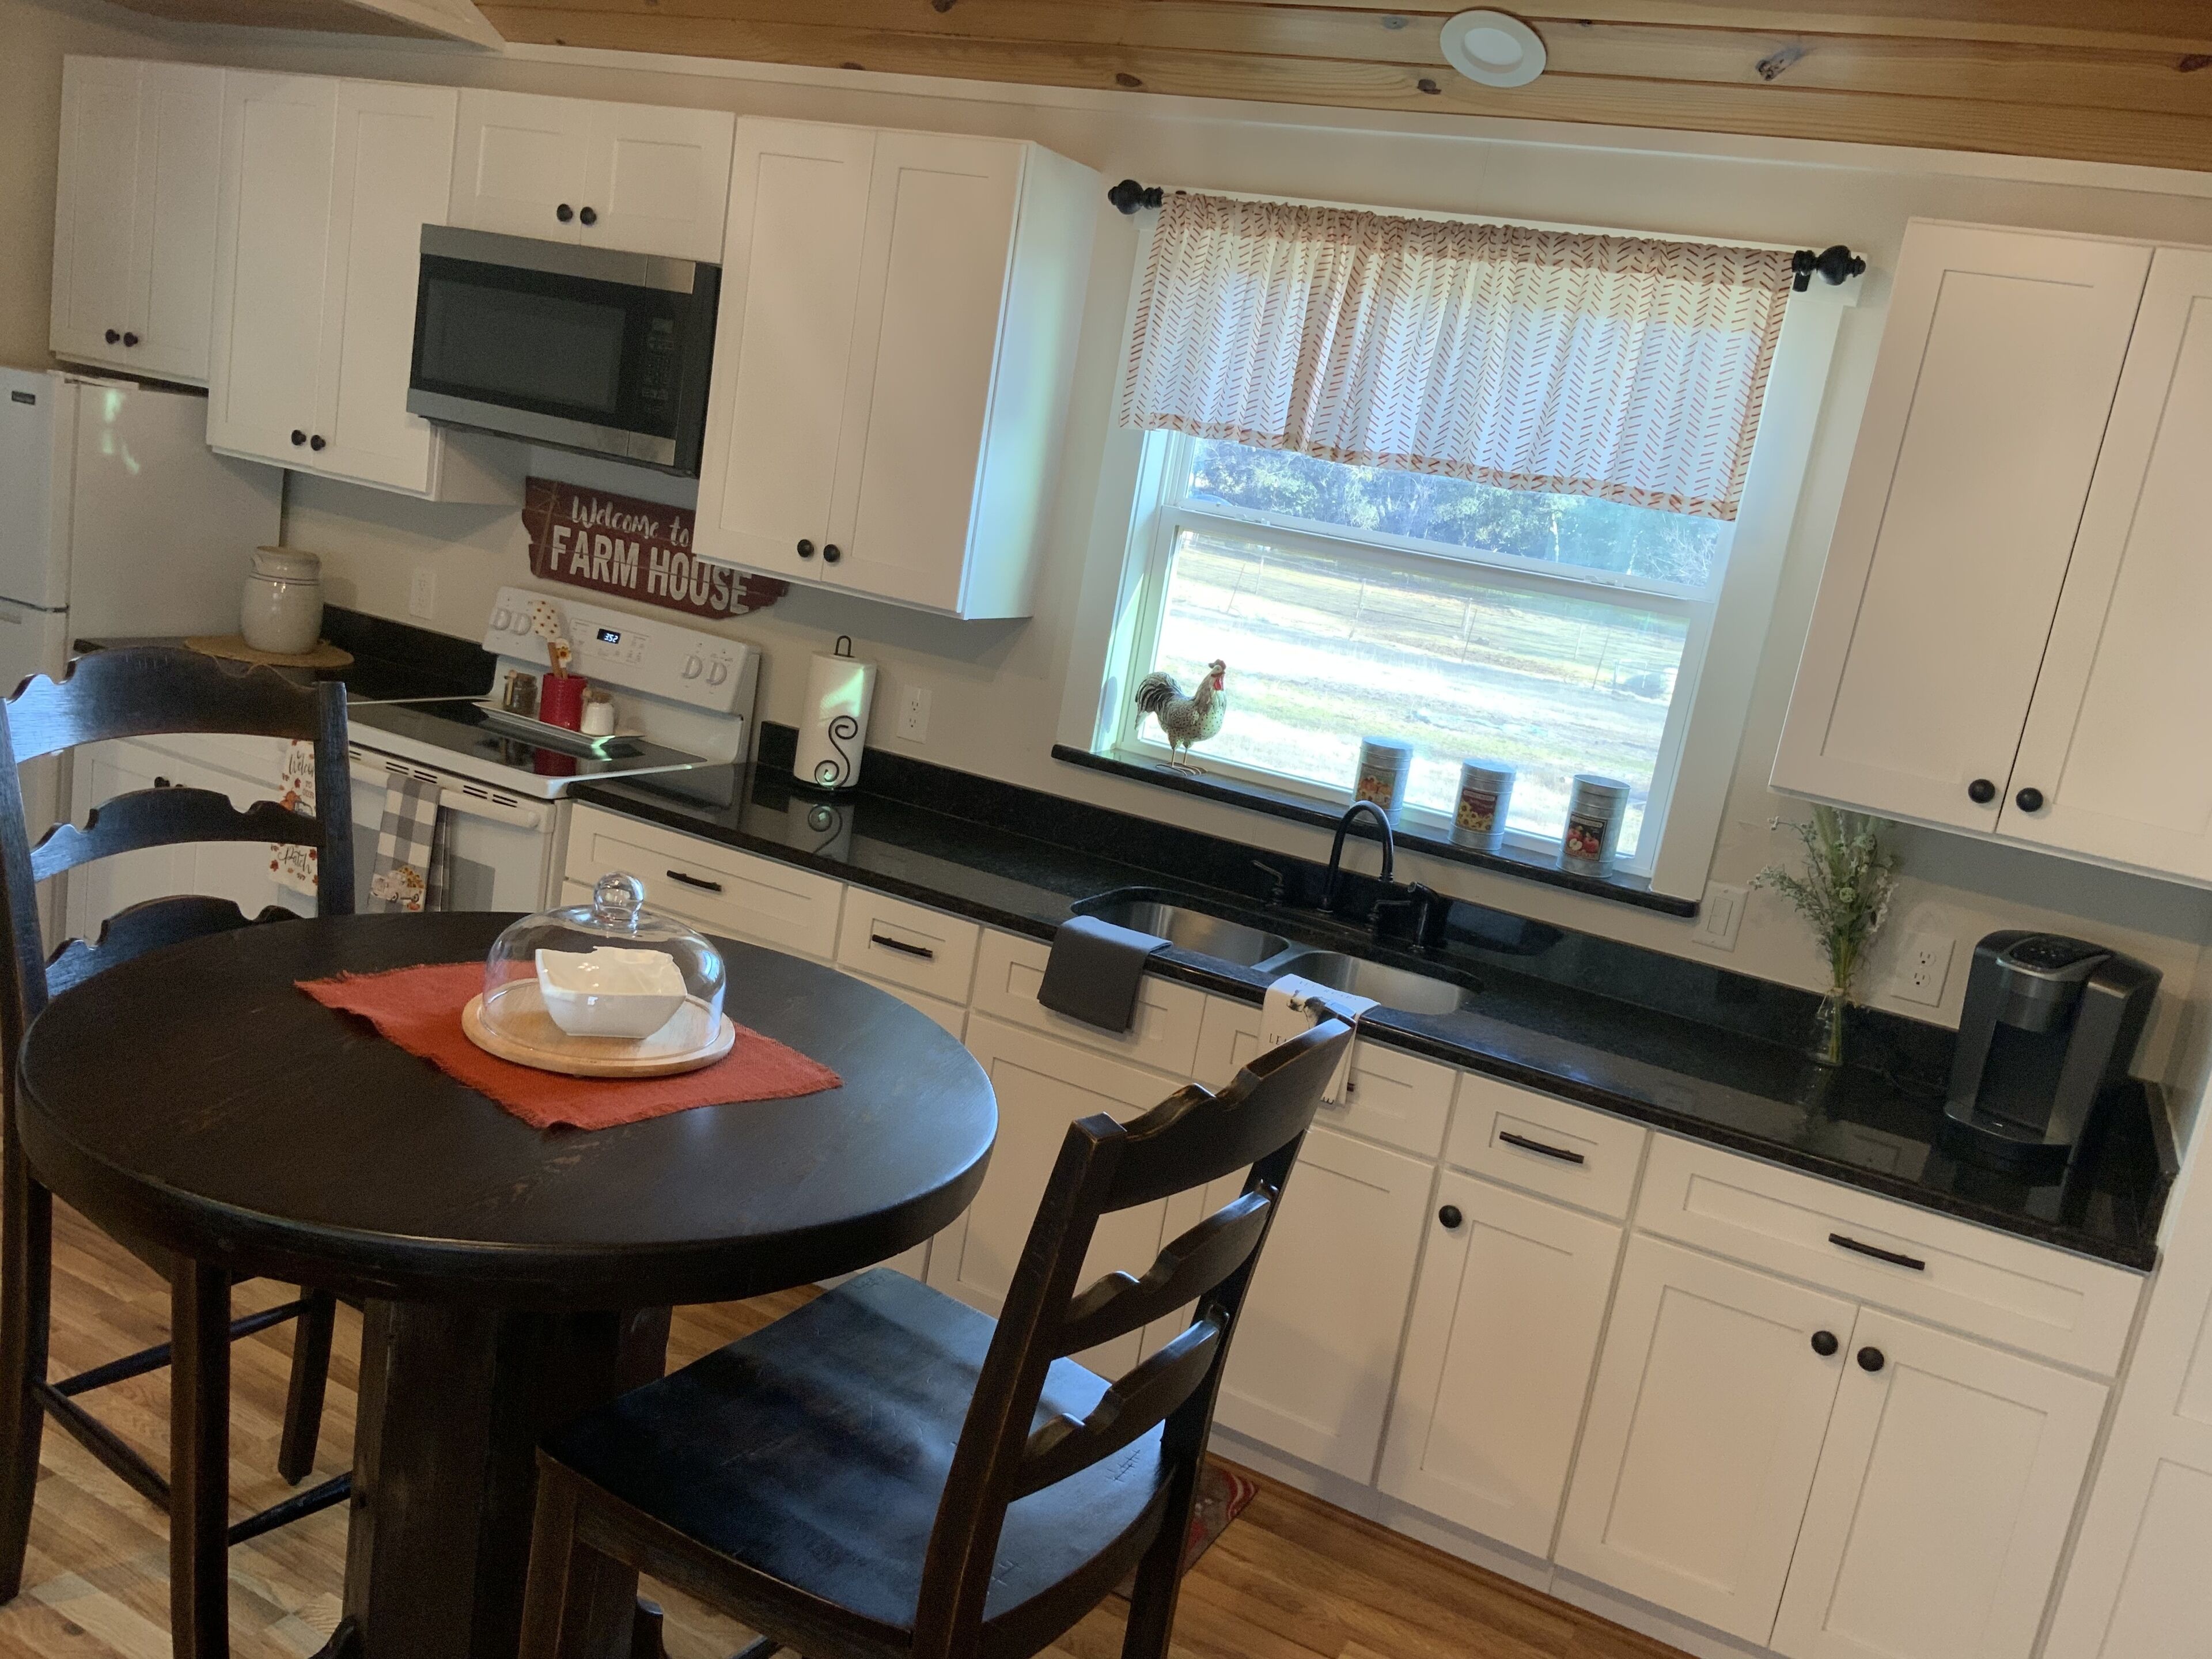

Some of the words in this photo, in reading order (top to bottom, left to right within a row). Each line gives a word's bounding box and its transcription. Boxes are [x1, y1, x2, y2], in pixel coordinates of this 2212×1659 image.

[572, 496, 660, 539] Welcome
[669, 516, 689, 547] to
[551, 525, 639, 589] FARM
[647, 546, 752, 615] HOUSE
